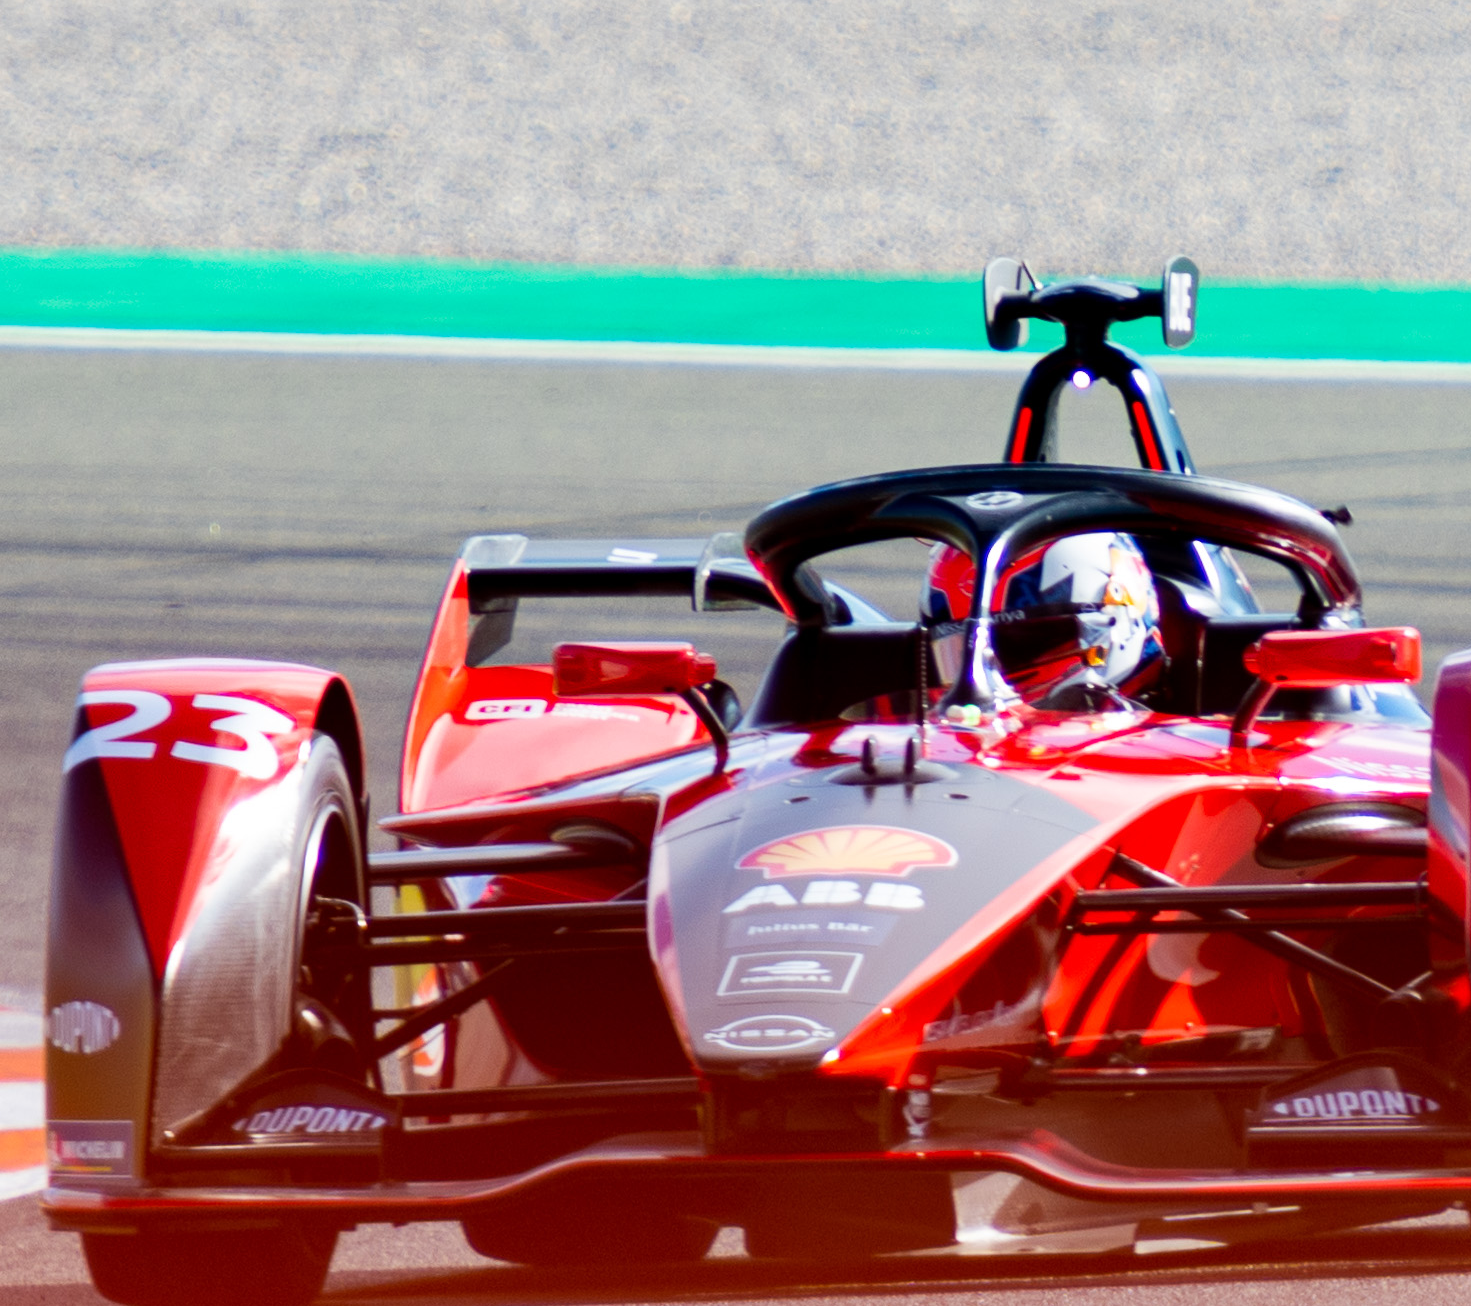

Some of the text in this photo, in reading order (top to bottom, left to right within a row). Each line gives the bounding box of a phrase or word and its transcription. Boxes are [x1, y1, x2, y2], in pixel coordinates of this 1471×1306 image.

[62, 689, 297, 780] 23
[721, 880, 926, 913] ABB
[703, 1028, 836, 1041] NISSAN
[1293, 1089, 1423, 1119] DUPONT
[245, 1106, 374, 1133] DUPONT
